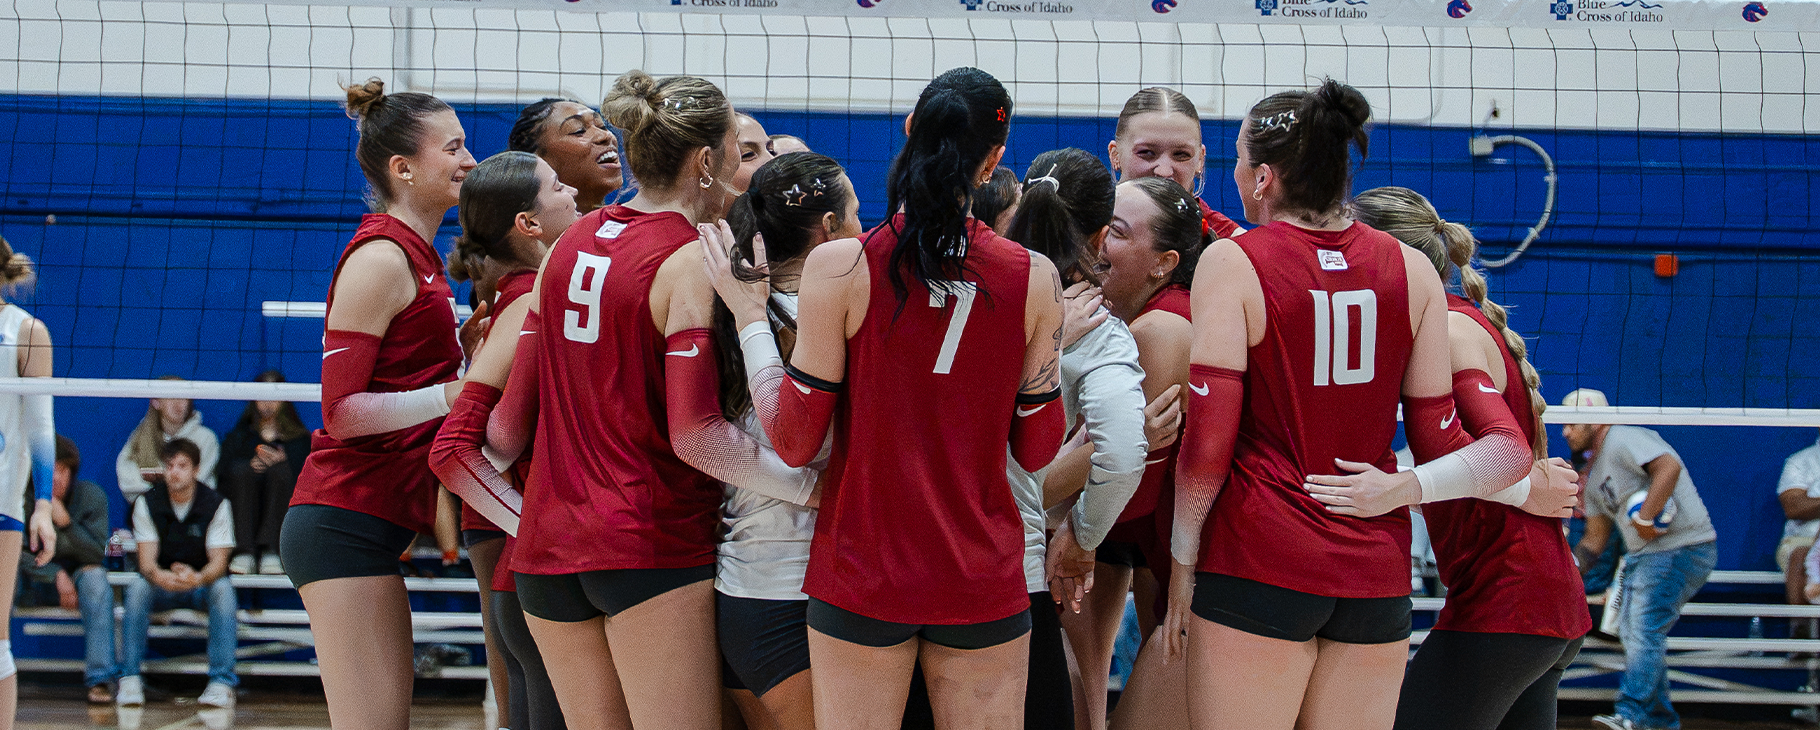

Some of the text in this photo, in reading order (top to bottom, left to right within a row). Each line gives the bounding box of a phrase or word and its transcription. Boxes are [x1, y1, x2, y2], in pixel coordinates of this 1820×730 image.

[987, 1, 1073, 13] Cross of Idaho
[1578, 0, 1606, 9] Blue
[1282, 6, 1368, 19] Cross of Idaho
[1577, 10, 1663, 22] Cross of Idaho
[564, 250, 611, 344] 9
[927, 279, 977, 374] 7
[1308, 289, 1377, 386] 10
